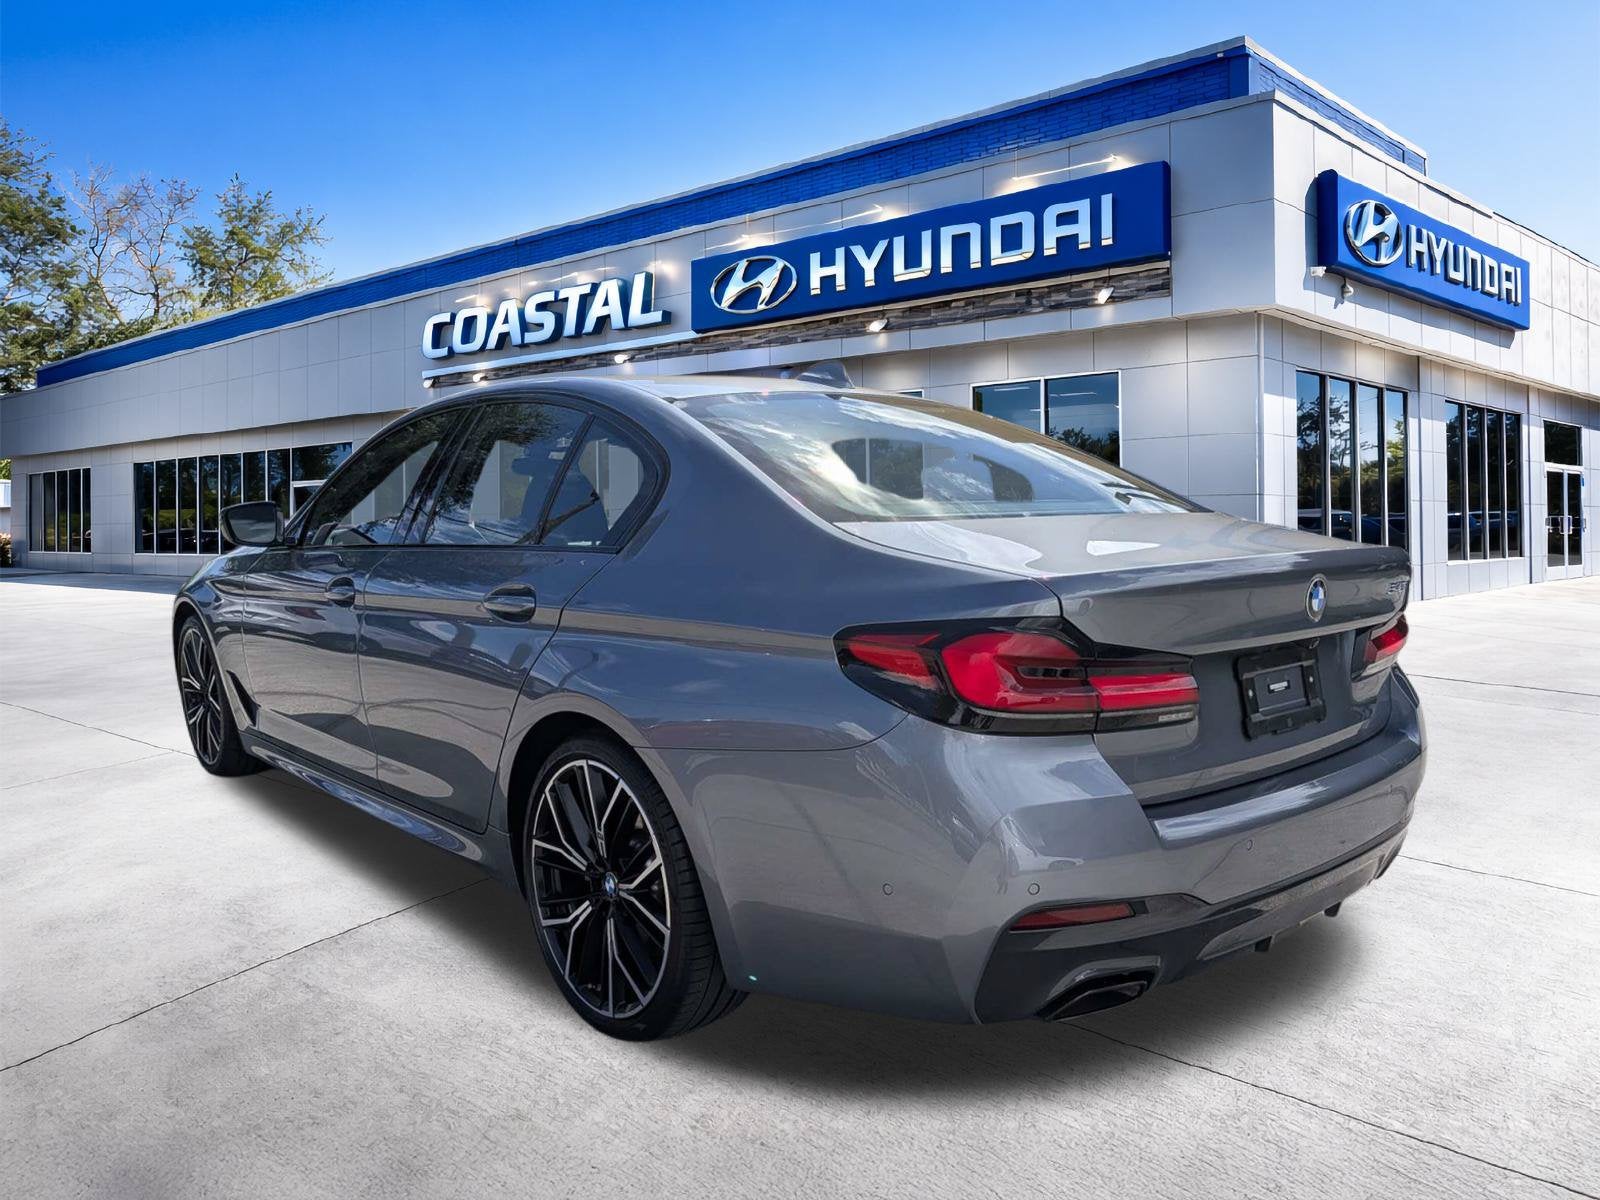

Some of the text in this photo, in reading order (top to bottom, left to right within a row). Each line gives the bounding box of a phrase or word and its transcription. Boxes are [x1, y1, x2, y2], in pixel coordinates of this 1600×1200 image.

[808, 193, 1114, 296] HYUNDAI
[1406, 224, 1522, 306] HYUNDAI
[422, 271, 668, 359] COASTAL
